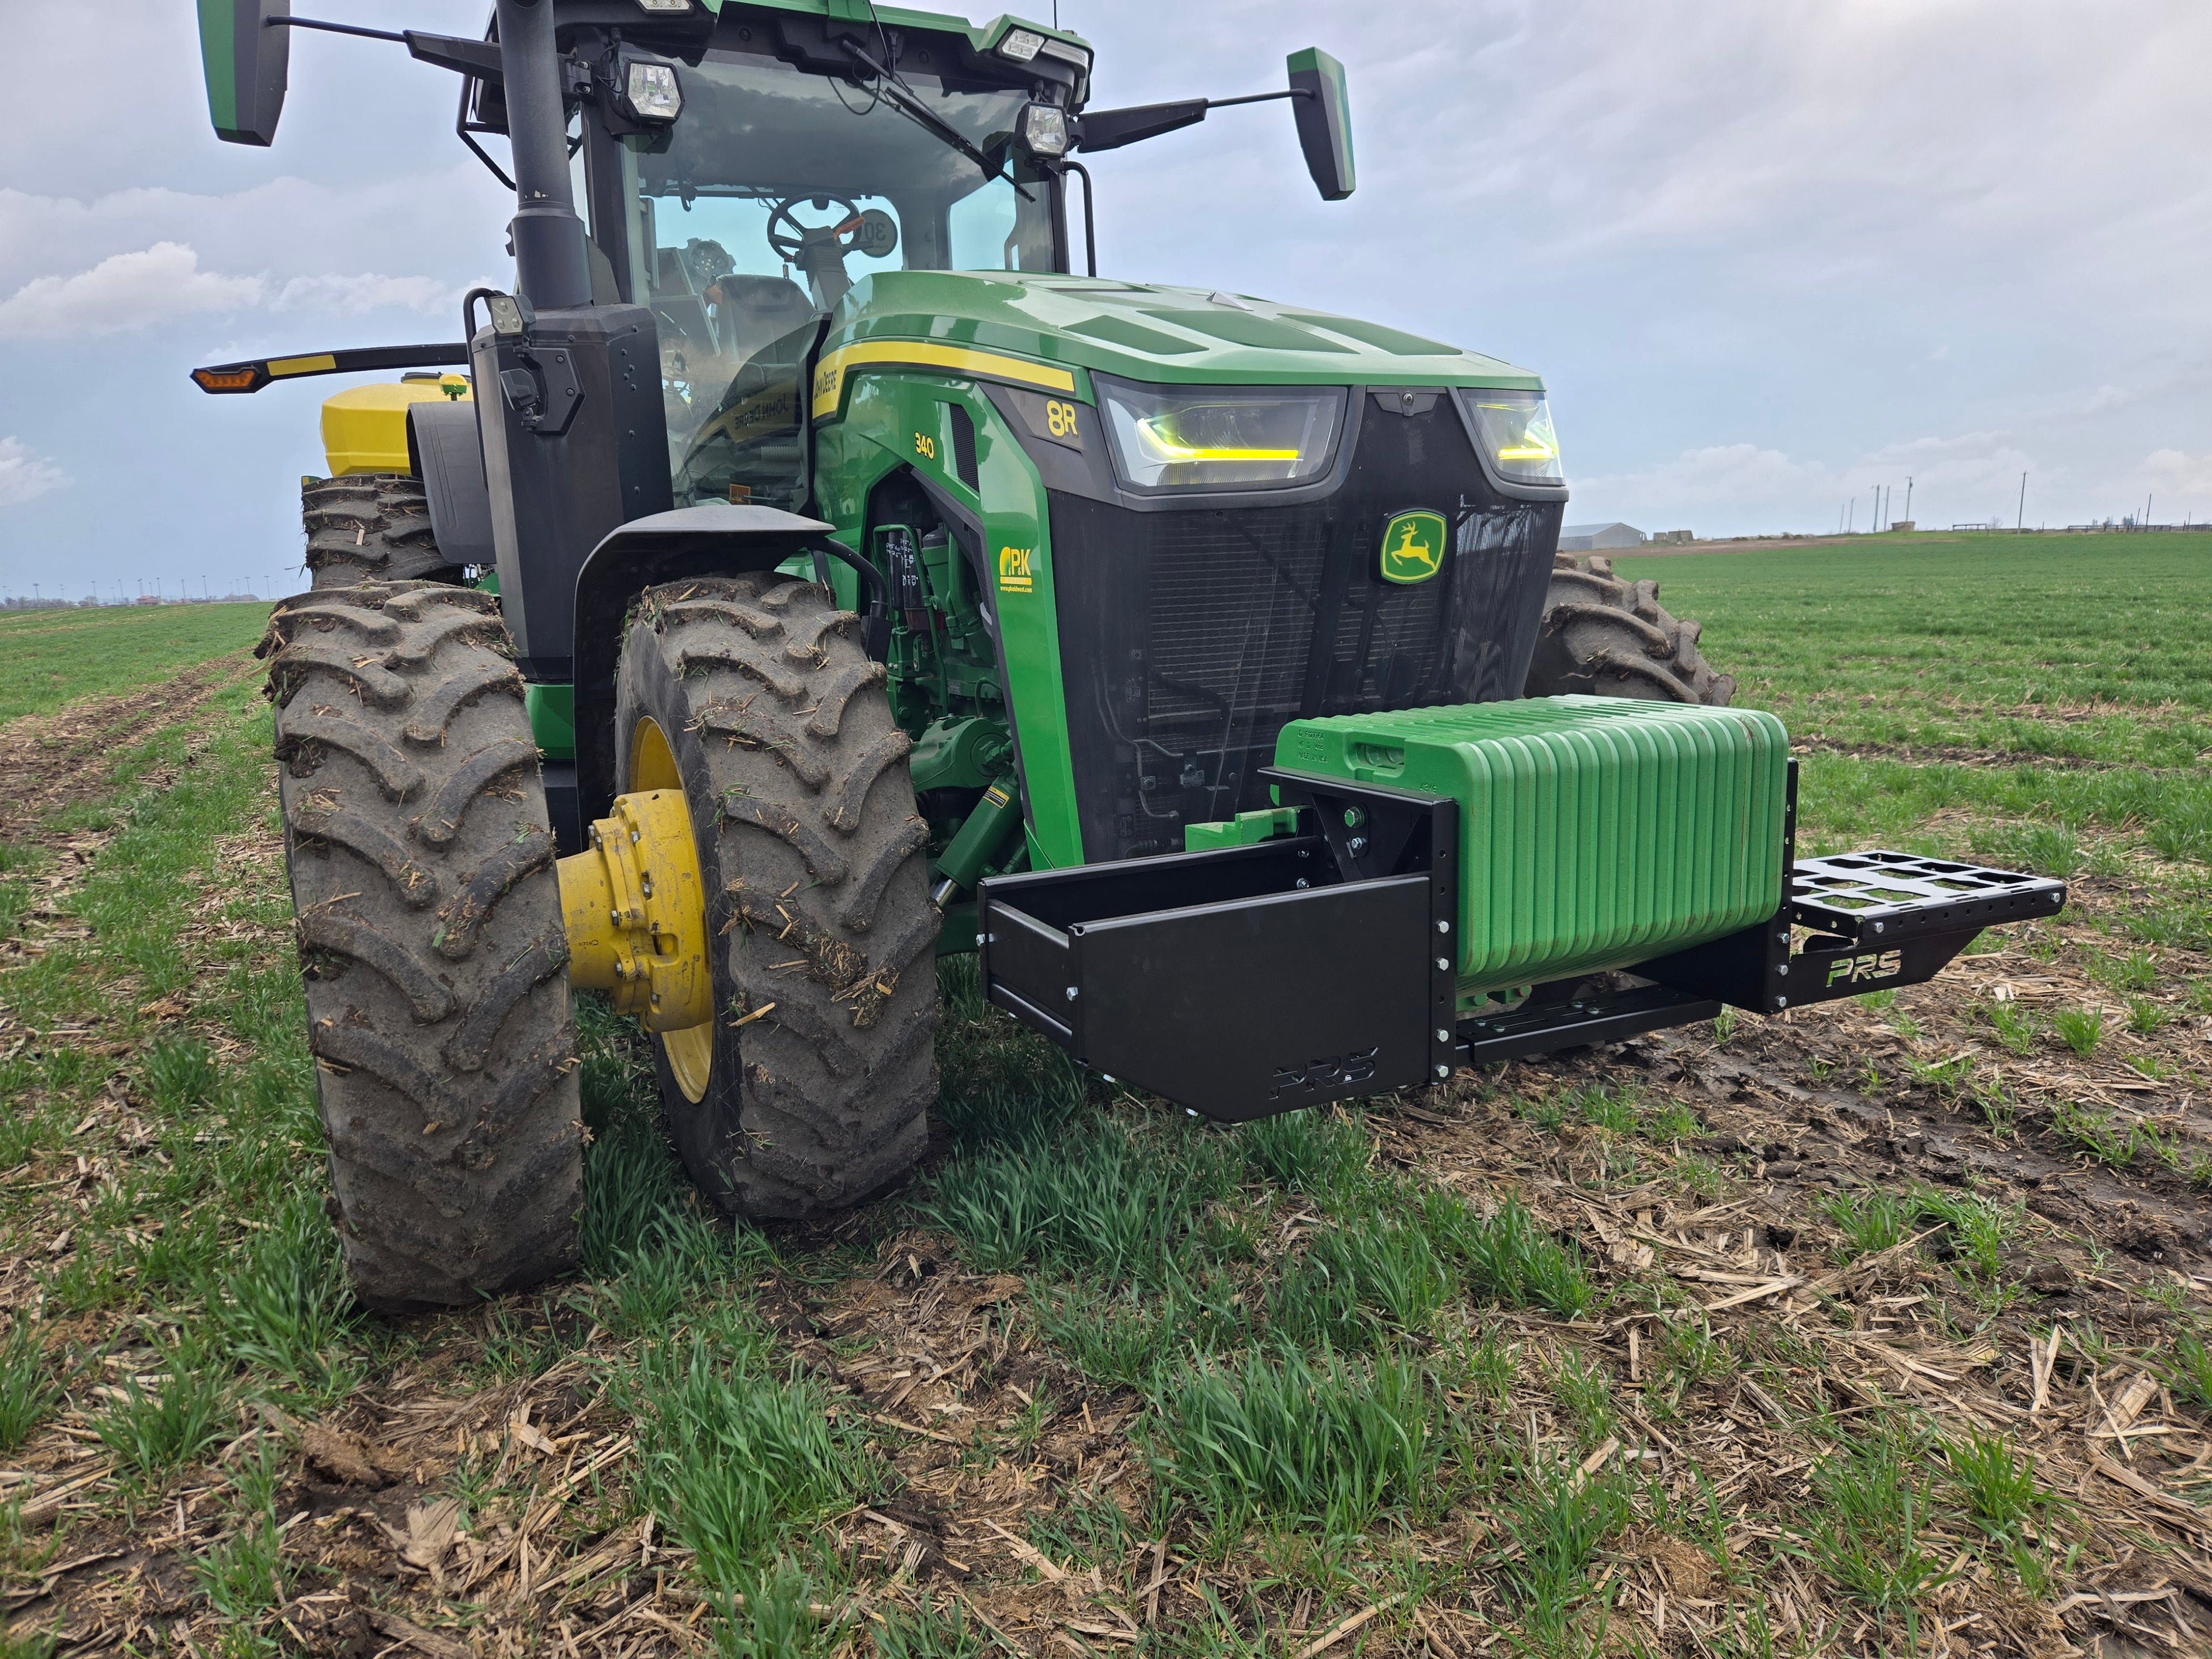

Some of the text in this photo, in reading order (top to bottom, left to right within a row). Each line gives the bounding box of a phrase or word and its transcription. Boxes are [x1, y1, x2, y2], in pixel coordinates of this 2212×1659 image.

[822, 369, 837, 394] DEERE
[1047, 400, 1078, 437] 8R
[915, 431, 934, 460] 340
[1826, 949, 1903, 988] PRS
[1268, 1046, 1380, 1101] PRS
